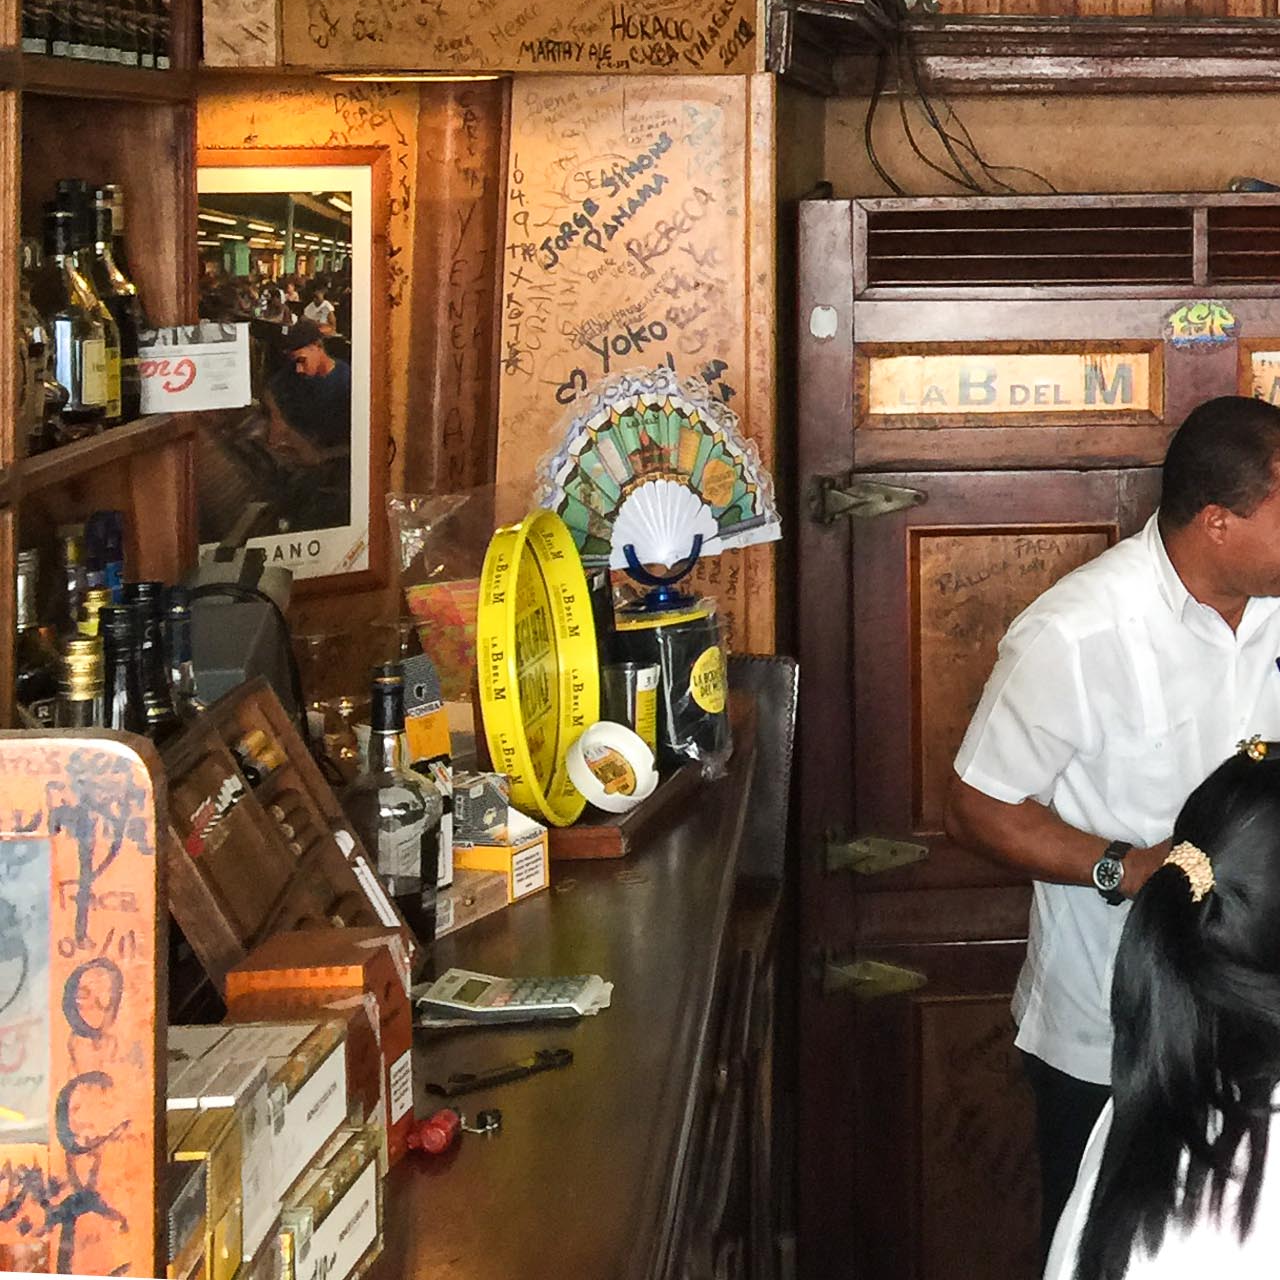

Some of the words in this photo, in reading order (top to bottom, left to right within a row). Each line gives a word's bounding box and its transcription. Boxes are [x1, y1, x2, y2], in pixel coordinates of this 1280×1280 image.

[582, 320, 668, 373] YOKO
[957, 364, 998, 406] B
[1008, 383, 1072, 405] DEL
[1083, 362, 1133, 405] M
